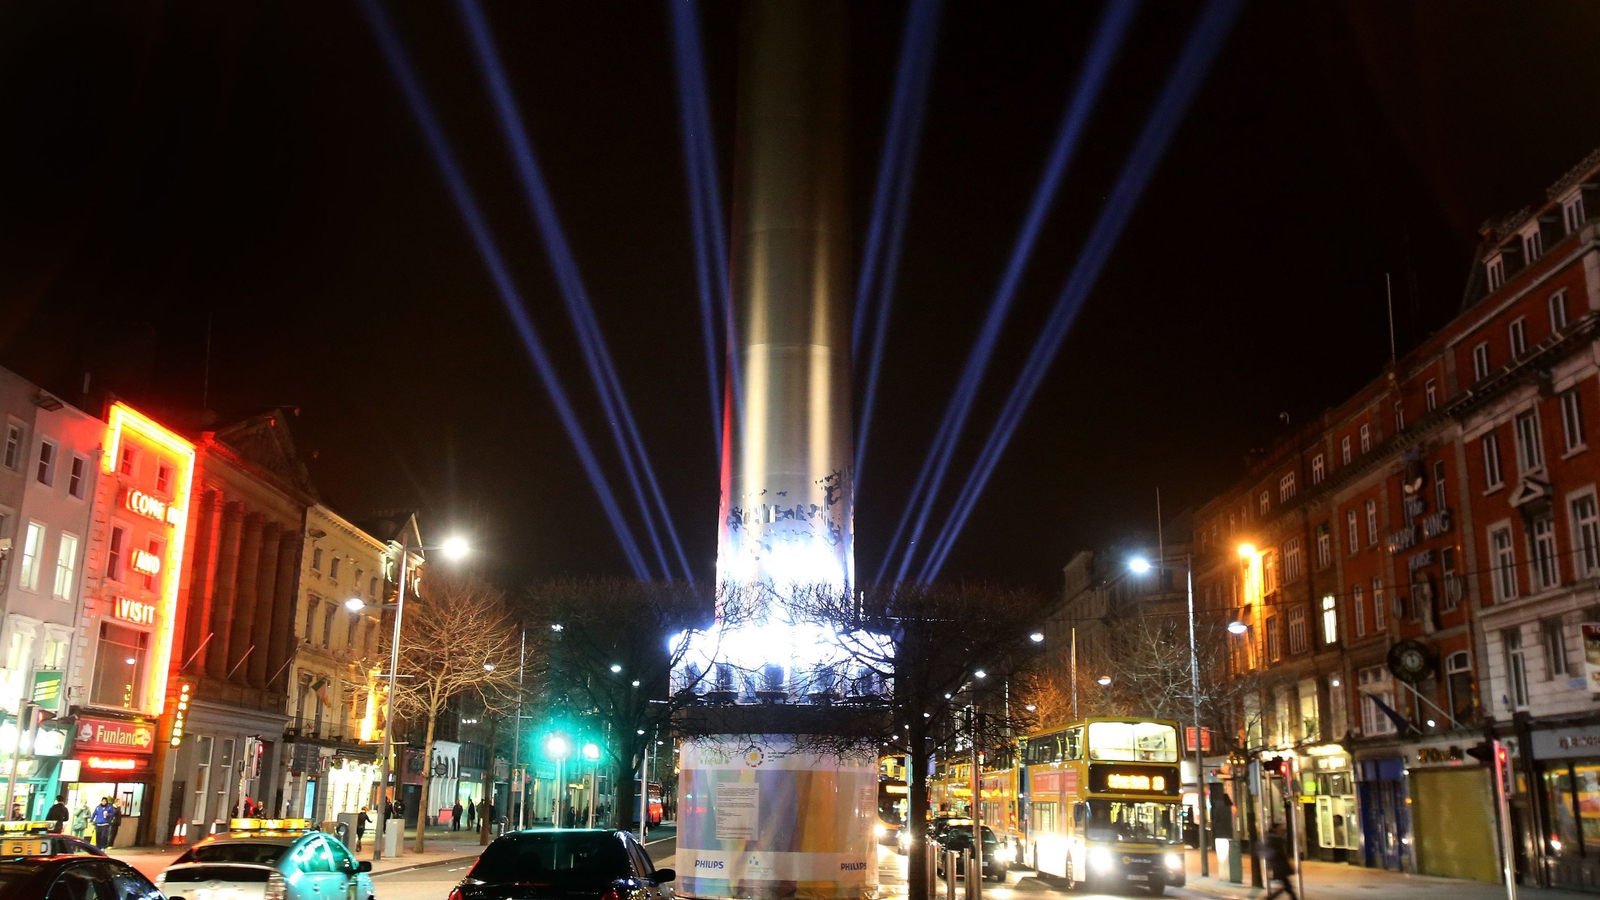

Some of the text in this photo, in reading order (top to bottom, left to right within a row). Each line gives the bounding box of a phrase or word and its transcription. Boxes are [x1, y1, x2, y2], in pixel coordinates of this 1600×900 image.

[131, 491, 165, 520] COME
[1423, 509, 1451, 539] RING
[136, 549, 160, 574] AND
[121, 598, 155, 624] VISIT
[171, 684, 190, 746] FUNLAND
[96, 725, 139, 746] Funland
[694, 859, 724, 869] PHILIPS
[840, 862, 867, 870] PHILIPS
